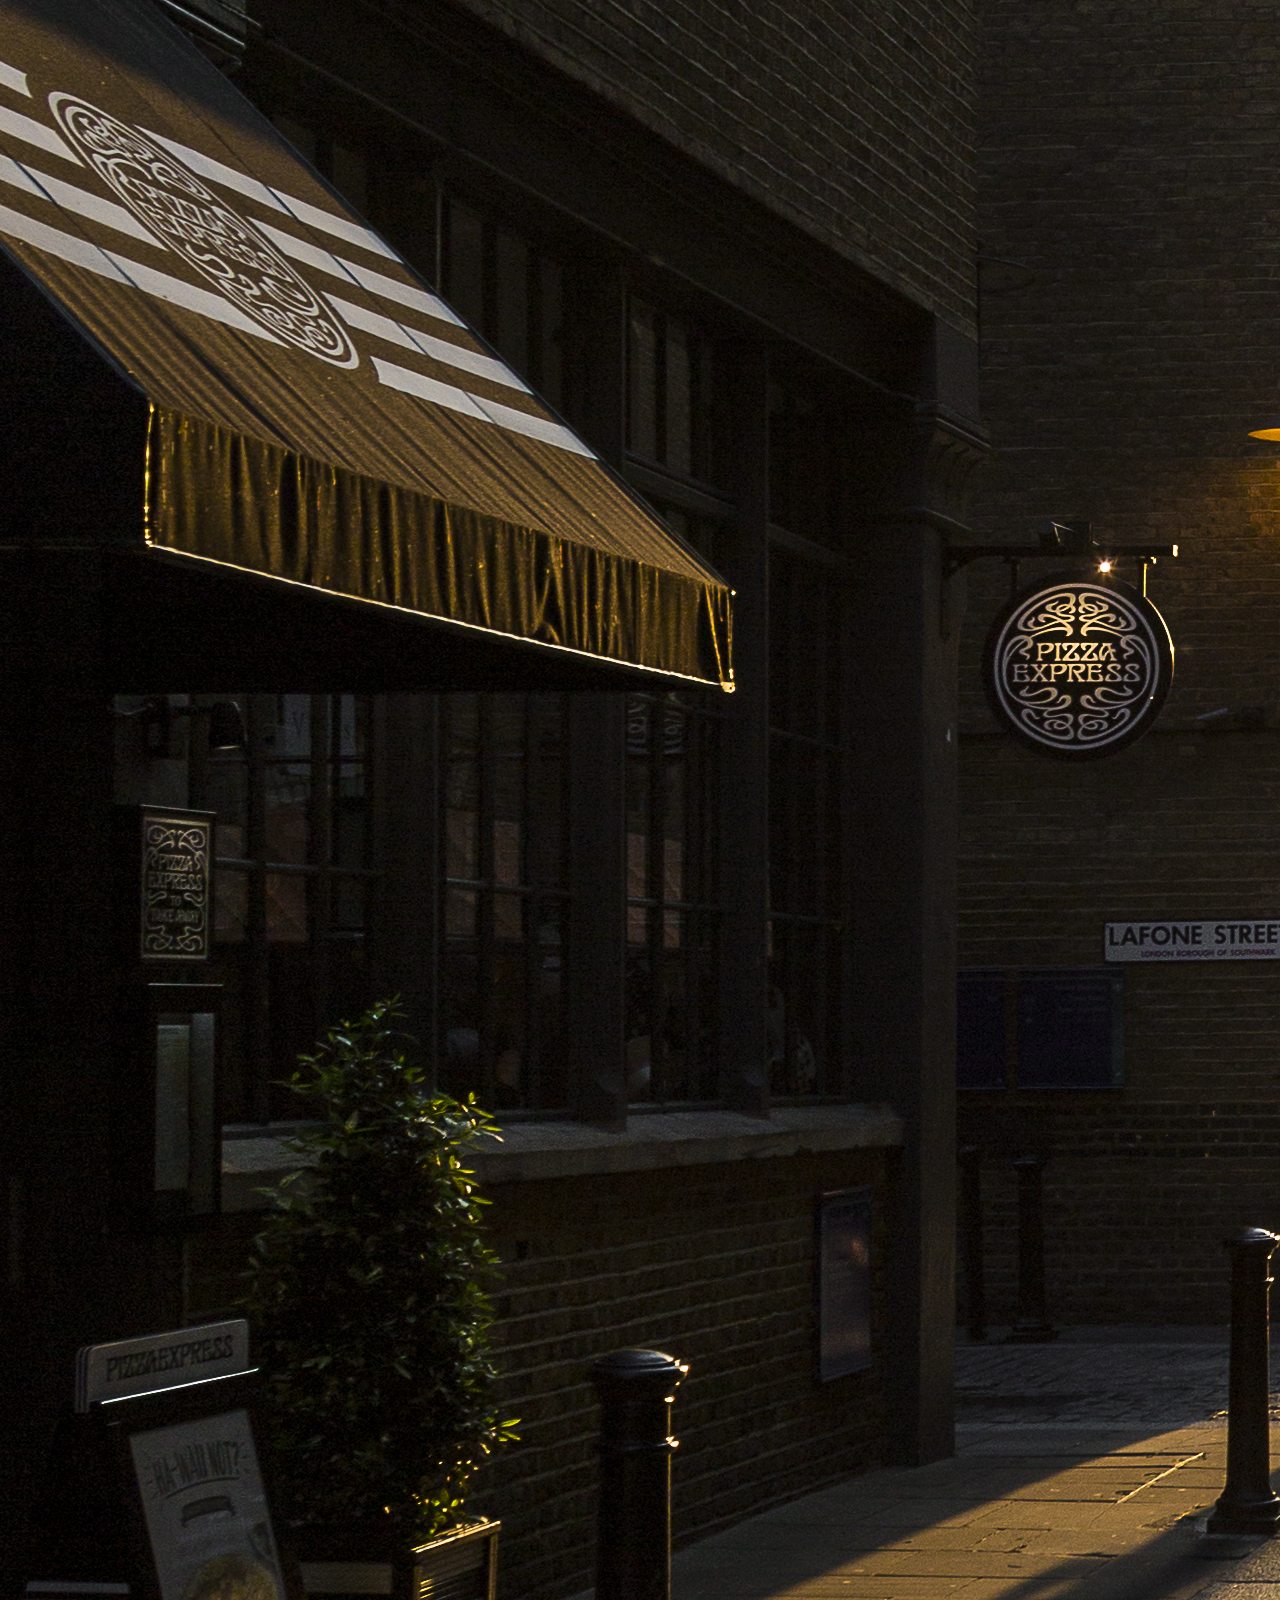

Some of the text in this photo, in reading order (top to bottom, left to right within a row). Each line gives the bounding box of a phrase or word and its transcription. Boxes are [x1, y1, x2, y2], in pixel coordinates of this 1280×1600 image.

[127, 175, 242, 246] PIZZA
[135, 199, 294, 284] EXPRESS
[1036, 642, 1117, 661] PIZZA
[1012, 663, 1140, 682] EXPRESS
[158, 853, 193, 872] PIZZA
[148, 871, 203, 891] EXPRESS
[1109, 926, 1203, 946] LAFONE
[1141, 949, 1174, 958] LONDON
[1176, 949, 1215, 957] BOROUGH
[1230, 948, 1276, 956] SOUTHWARK
